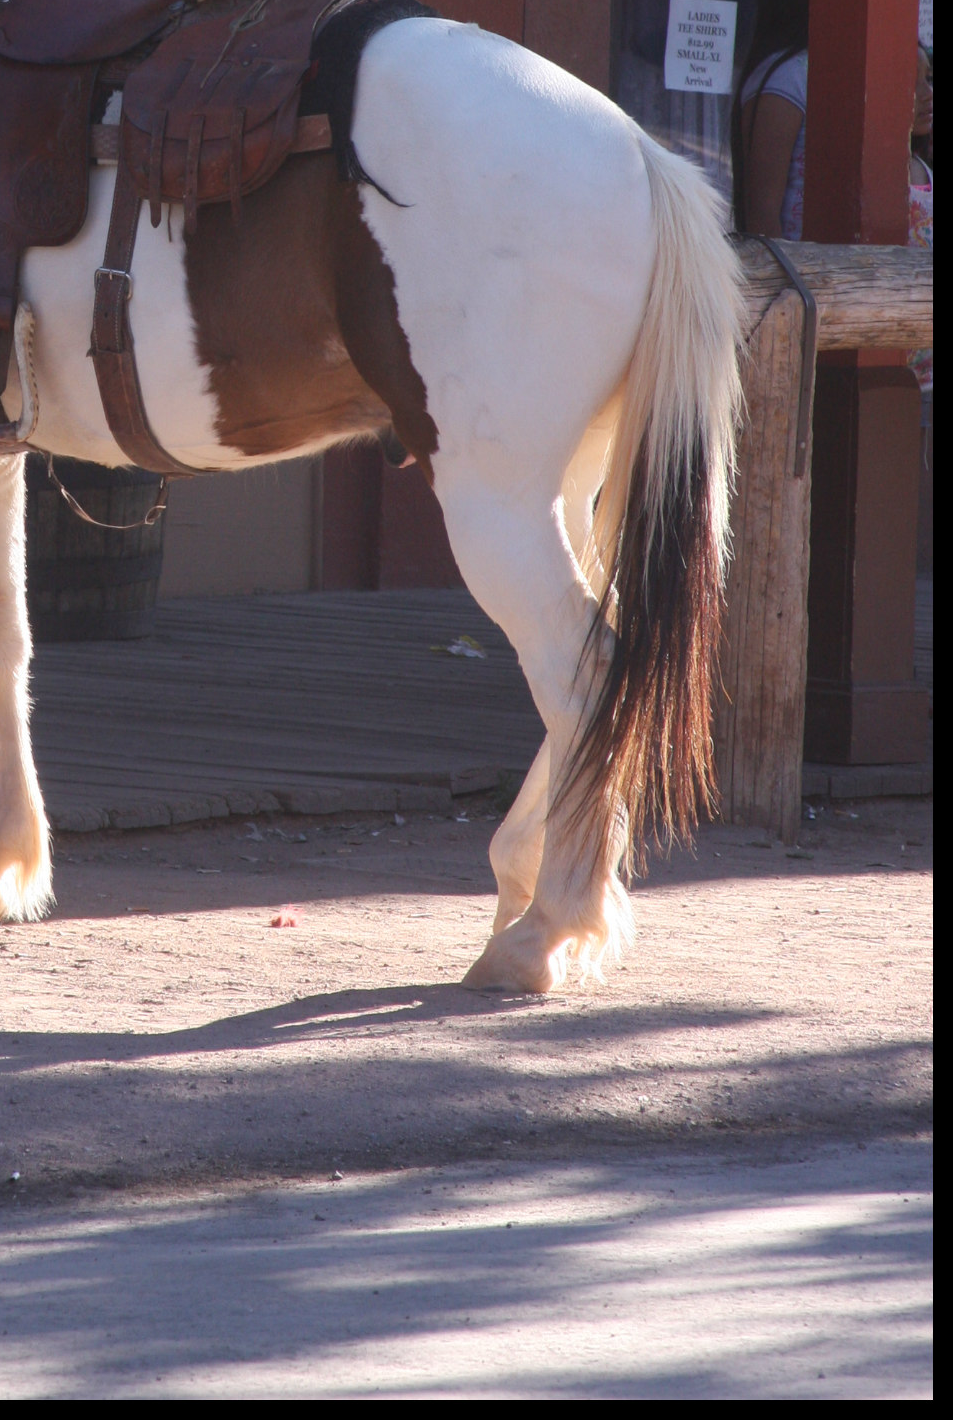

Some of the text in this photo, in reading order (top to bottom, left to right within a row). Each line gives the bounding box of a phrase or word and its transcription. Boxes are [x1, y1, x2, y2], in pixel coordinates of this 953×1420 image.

[687, 11, 720, 23] LADIES
[678, 23, 727, 37] TEE SHIRTS
[687, 38, 714, 49] $12.99
[677, 49, 721, 62] SMALL-XL
[689, 63, 706, 73] New
[684, 76, 712, 87] Arrival
